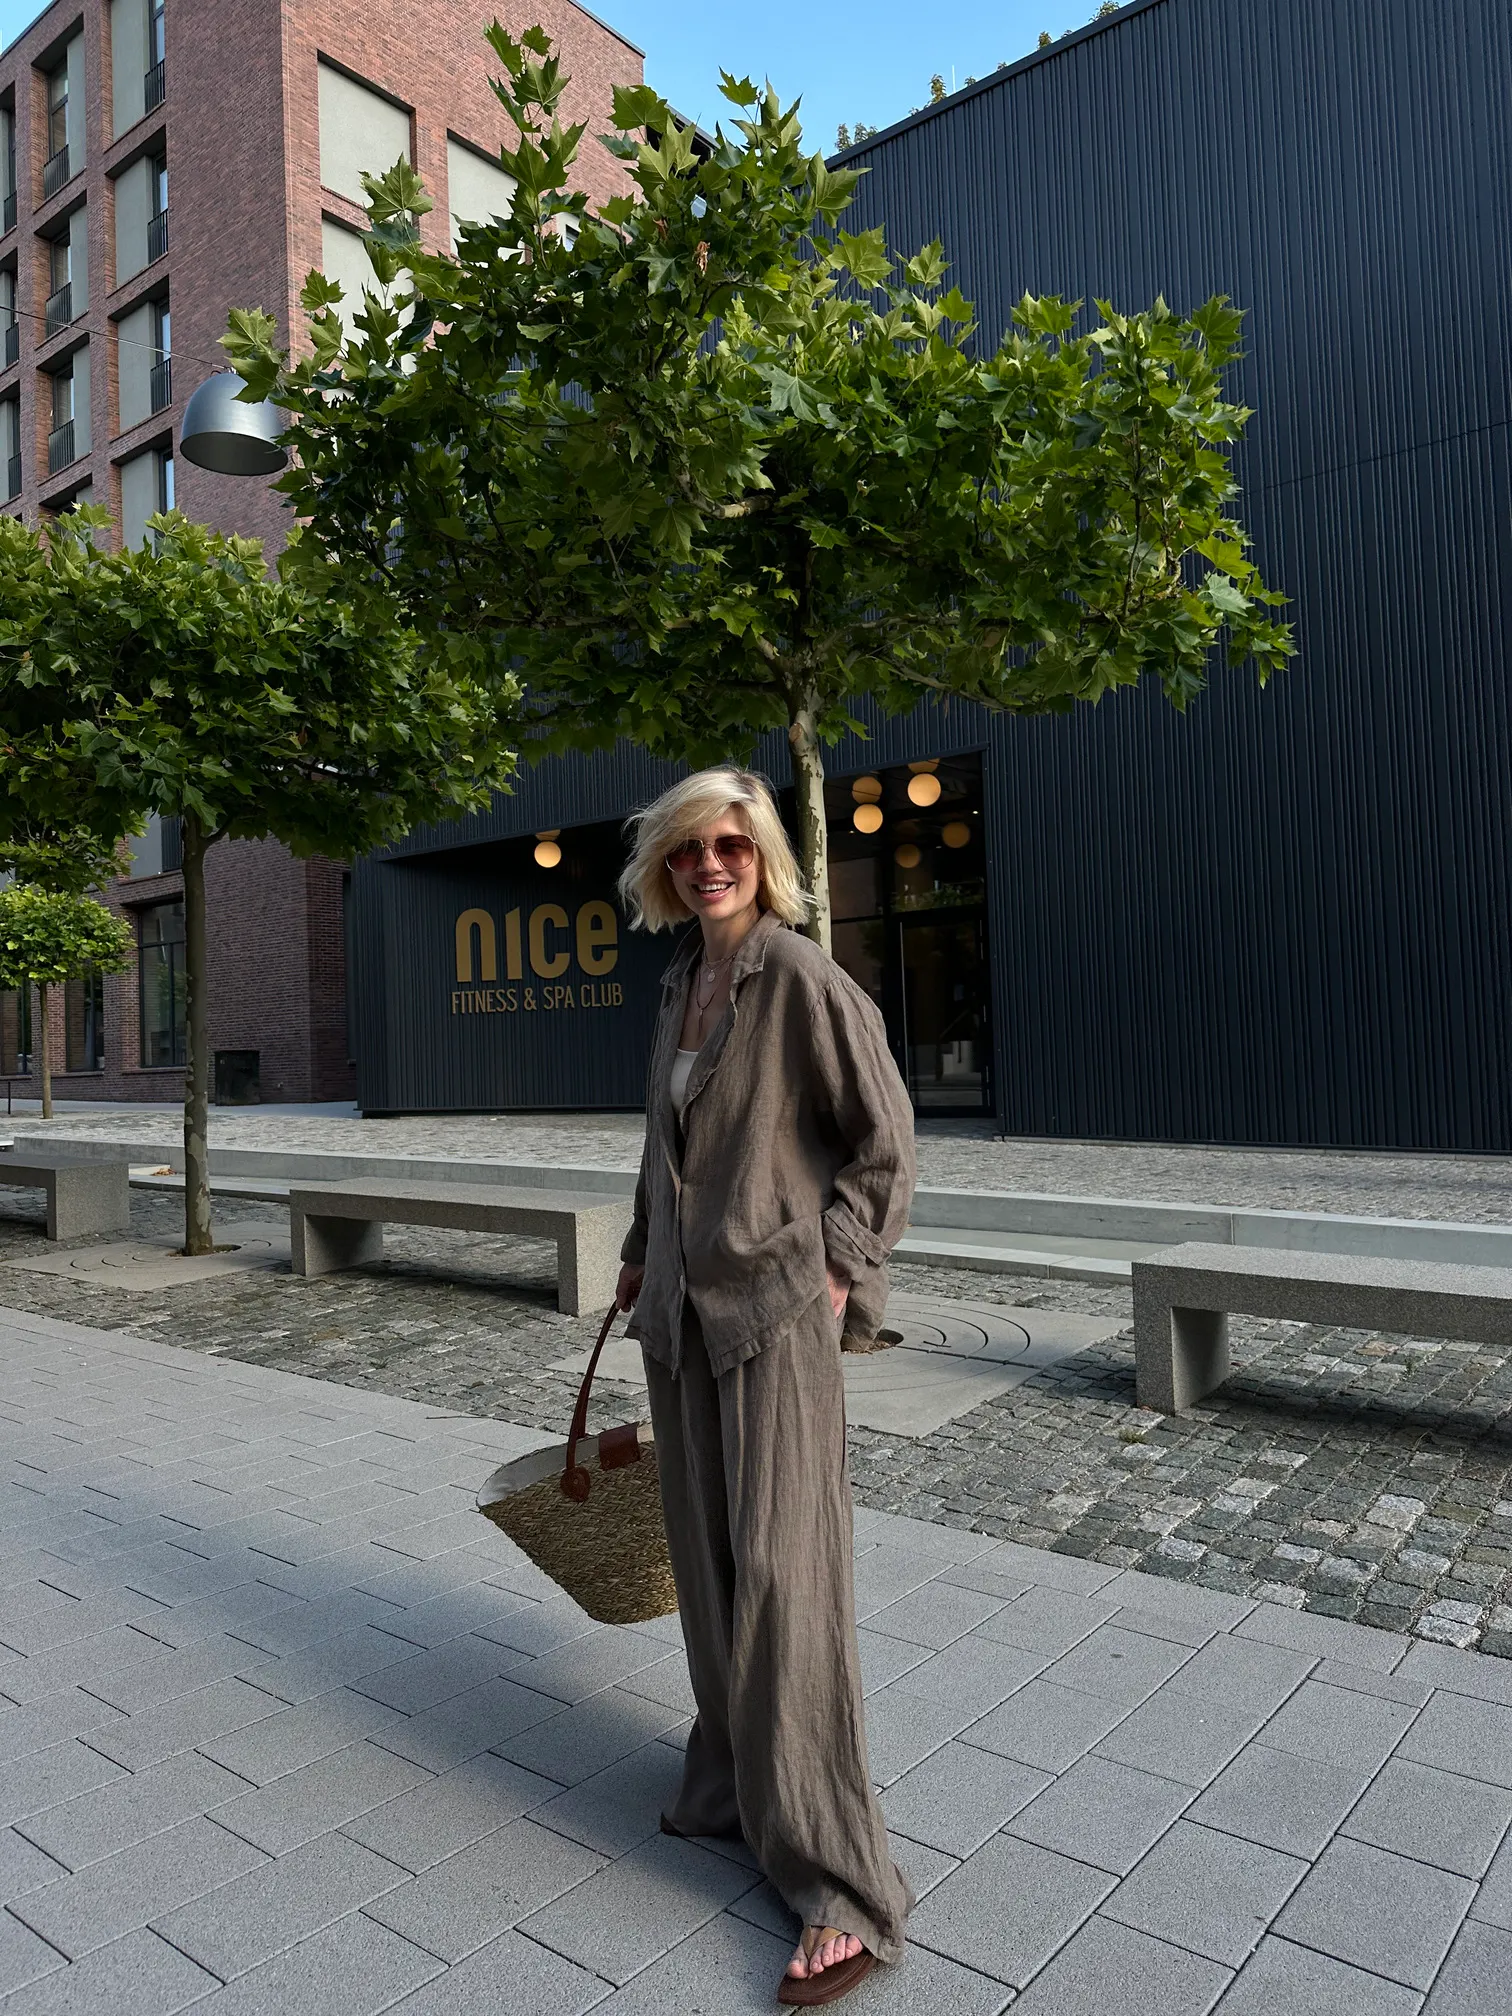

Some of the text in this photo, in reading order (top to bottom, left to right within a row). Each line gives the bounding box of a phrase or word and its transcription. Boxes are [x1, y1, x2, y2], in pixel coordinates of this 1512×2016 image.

[452, 983, 623, 1014] FITNESS & SPA CLUB
